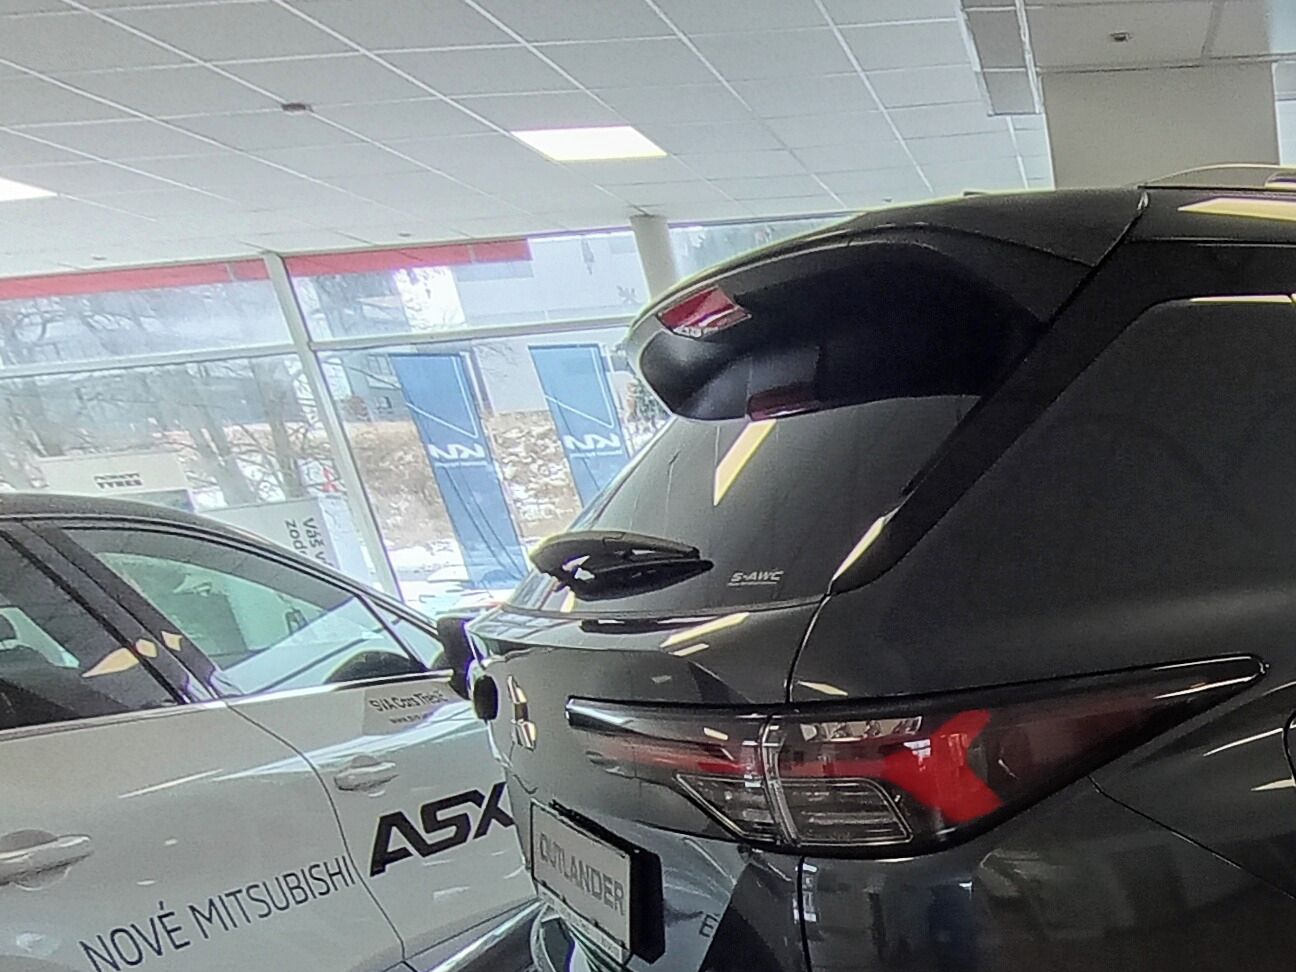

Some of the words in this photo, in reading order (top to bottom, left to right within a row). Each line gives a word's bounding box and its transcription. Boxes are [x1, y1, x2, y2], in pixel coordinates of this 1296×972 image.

[731, 571, 784, 582] S-AWC
[369, 782, 516, 877] ASX
[188, 856, 357, 939] MITSUBISHI
